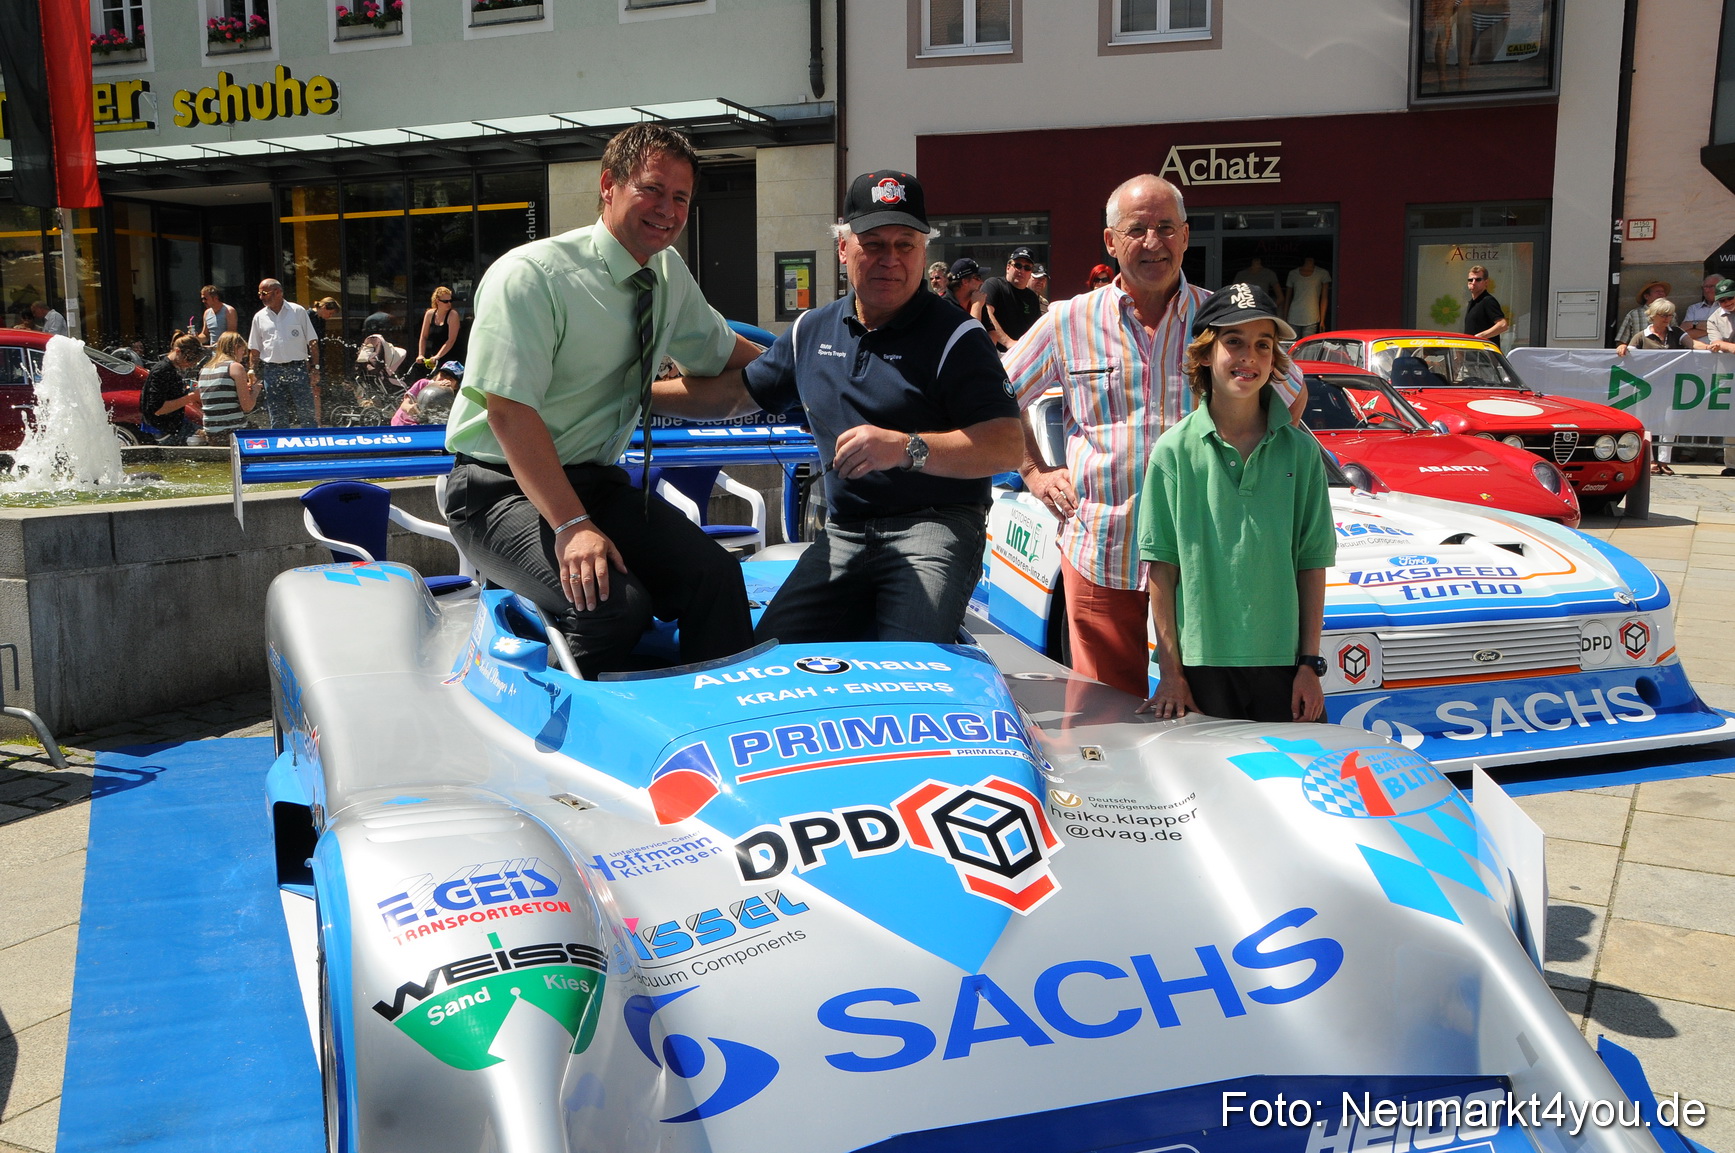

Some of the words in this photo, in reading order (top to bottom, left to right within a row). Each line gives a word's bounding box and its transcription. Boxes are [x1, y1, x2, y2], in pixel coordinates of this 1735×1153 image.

[1507, 42, 1537, 52] CALIDA
[172, 64, 340, 128] schuhe
[1158, 145, 1281, 186] Achatz
[526, 201, 537, 242] chuhe
[1450, 246, 1499, 261] Achatz
[276, 434, 412, 449] Müllerbräu
[1419, 465, 1489, 473] ABARTH
[1336, 540, 1367, 549] acuum
[996, 543, 1049, 586] www.motoren-linz.de
[1398, 555, 1430, 566] Ford
[1400, 580, 1523, 600] turbo
[1581, 636, 1612, 651] DPD
[693, 665, 791, 690] Auto
[850, 659, 952, 672] haus
[736, 686, 817, 706] KRAH
[852, 681, 954, 696] ENDERS
[1435, 686, 1656, 741] SACHS
[957, 748, 1019, 756] PRIMAGAZ
[1365, 752, 1393, 763] TEAM
[1088, 796, 1136, 804] Deutsche
[1091, 791, 1197, 811] Vermögensberatung
[1050, 804, 1198, 827] heiko.klapper
[1065, 824, 1183, 842] @dvag.de
[734, 809, 900, 881] DPD
[619, 845, 723, 878] Kitzingen
[393, 901, 572, 946] TRANSPORTBETON
[691, 928, 807, 976] Components
[427, 986, 491, 1027] Sand
[543, 974, 590, 994] Kies
[817, 907, 1344, 1073] SACHS
